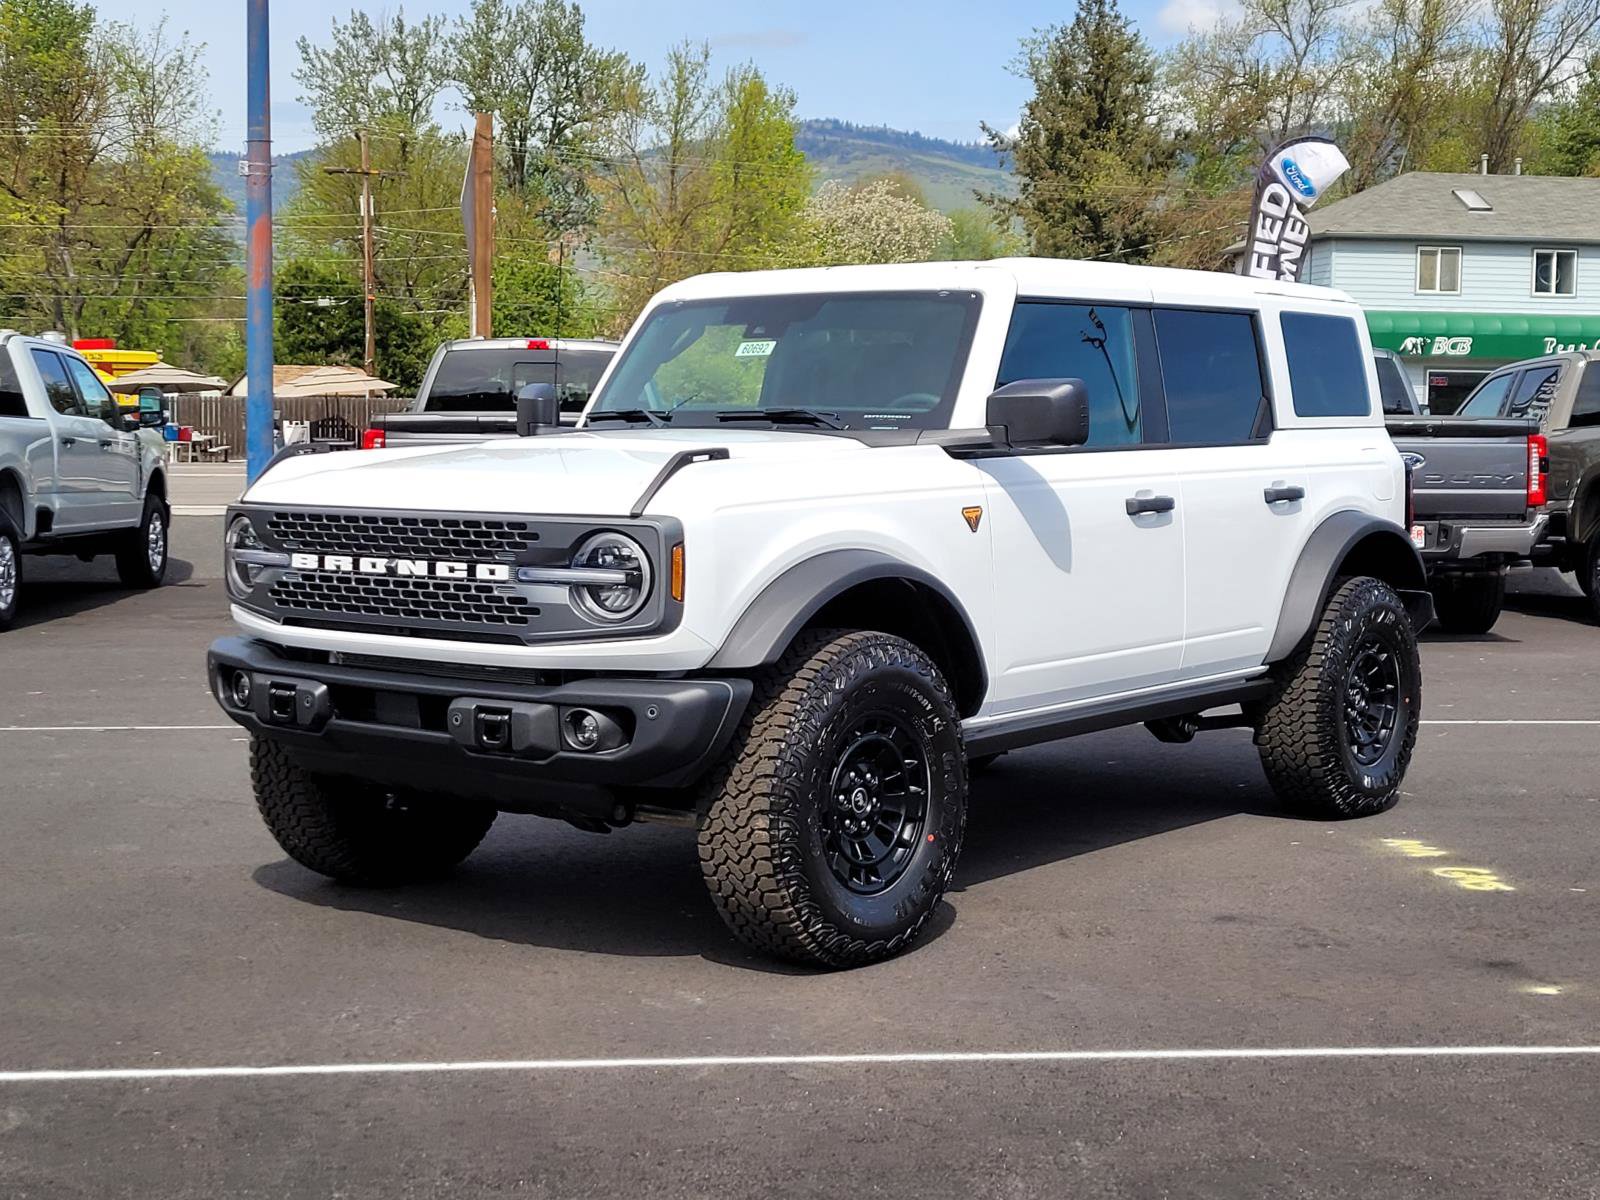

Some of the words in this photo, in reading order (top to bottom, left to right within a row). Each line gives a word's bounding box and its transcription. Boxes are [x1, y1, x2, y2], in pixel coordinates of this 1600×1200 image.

[1286, 164, 1309, 191] Ford
[741, 343, 770, 354] 60692
[1431, 336, 1473, 355] BCB
[1544, 336, 1587, 354] Bear
[1424, 474, 1514, 484] DUTY
[291, 552, 510, 581] BRONCO
